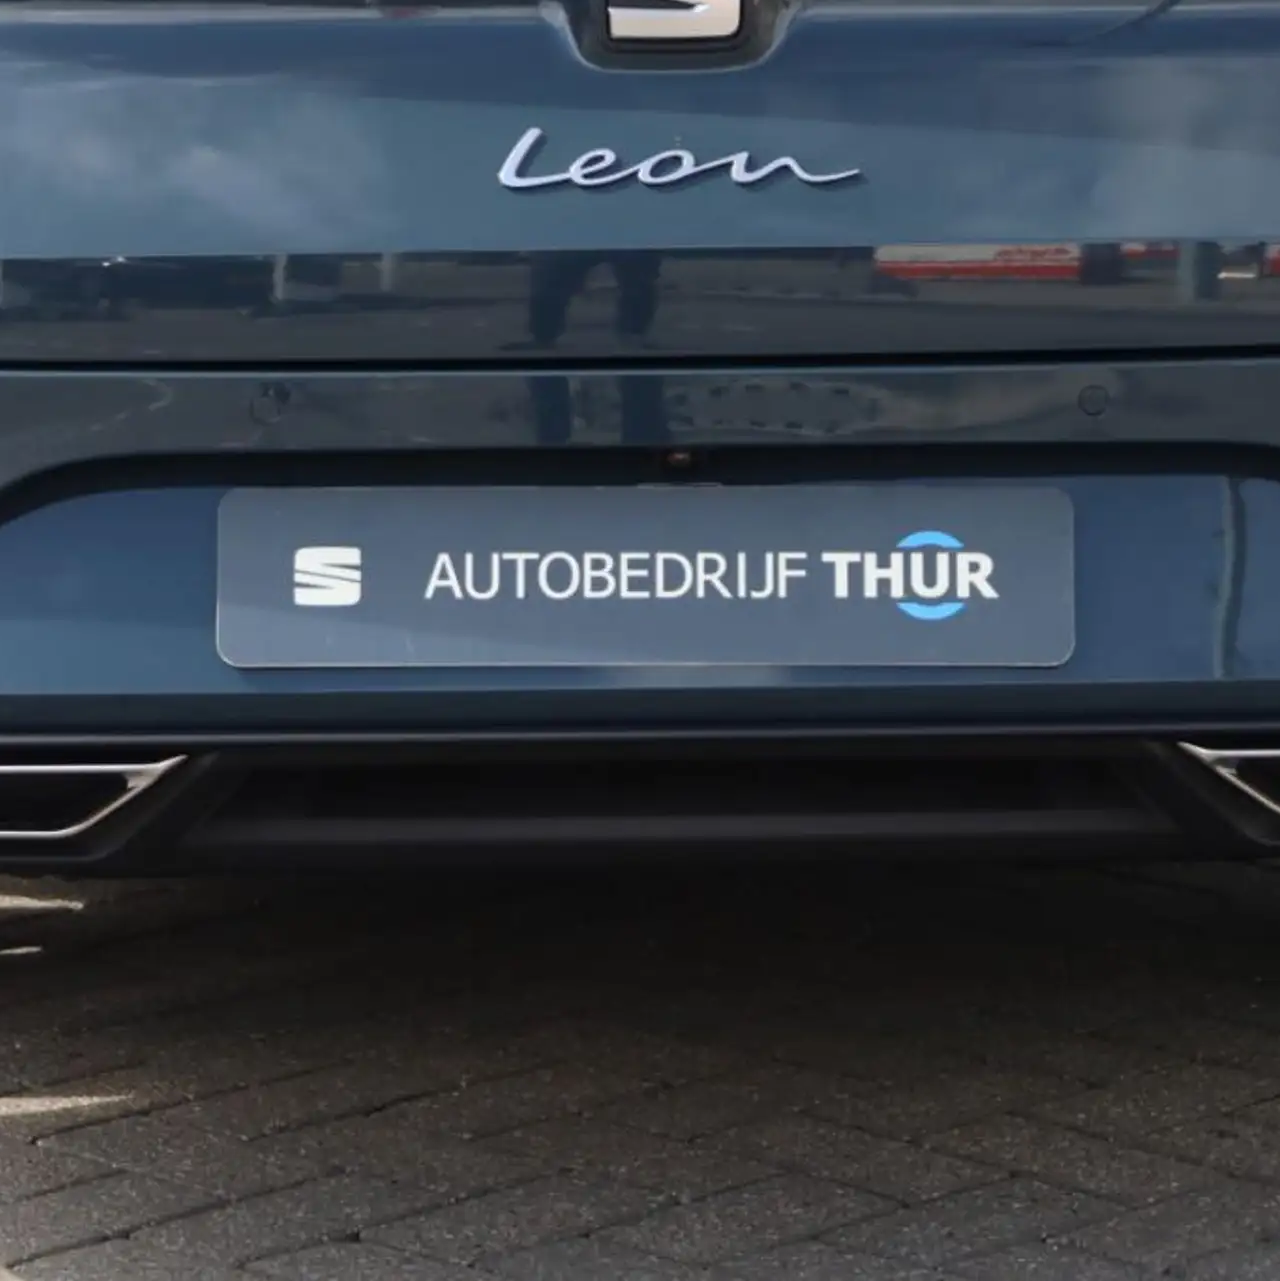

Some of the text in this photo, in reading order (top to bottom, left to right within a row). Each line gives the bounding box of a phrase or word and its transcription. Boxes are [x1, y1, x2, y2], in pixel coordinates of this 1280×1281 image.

[497, 127, 861, 189] Leon
[423, 551, 808, 600] AUTOBEDRIJF
[822, 551, 999, 600] THUR
